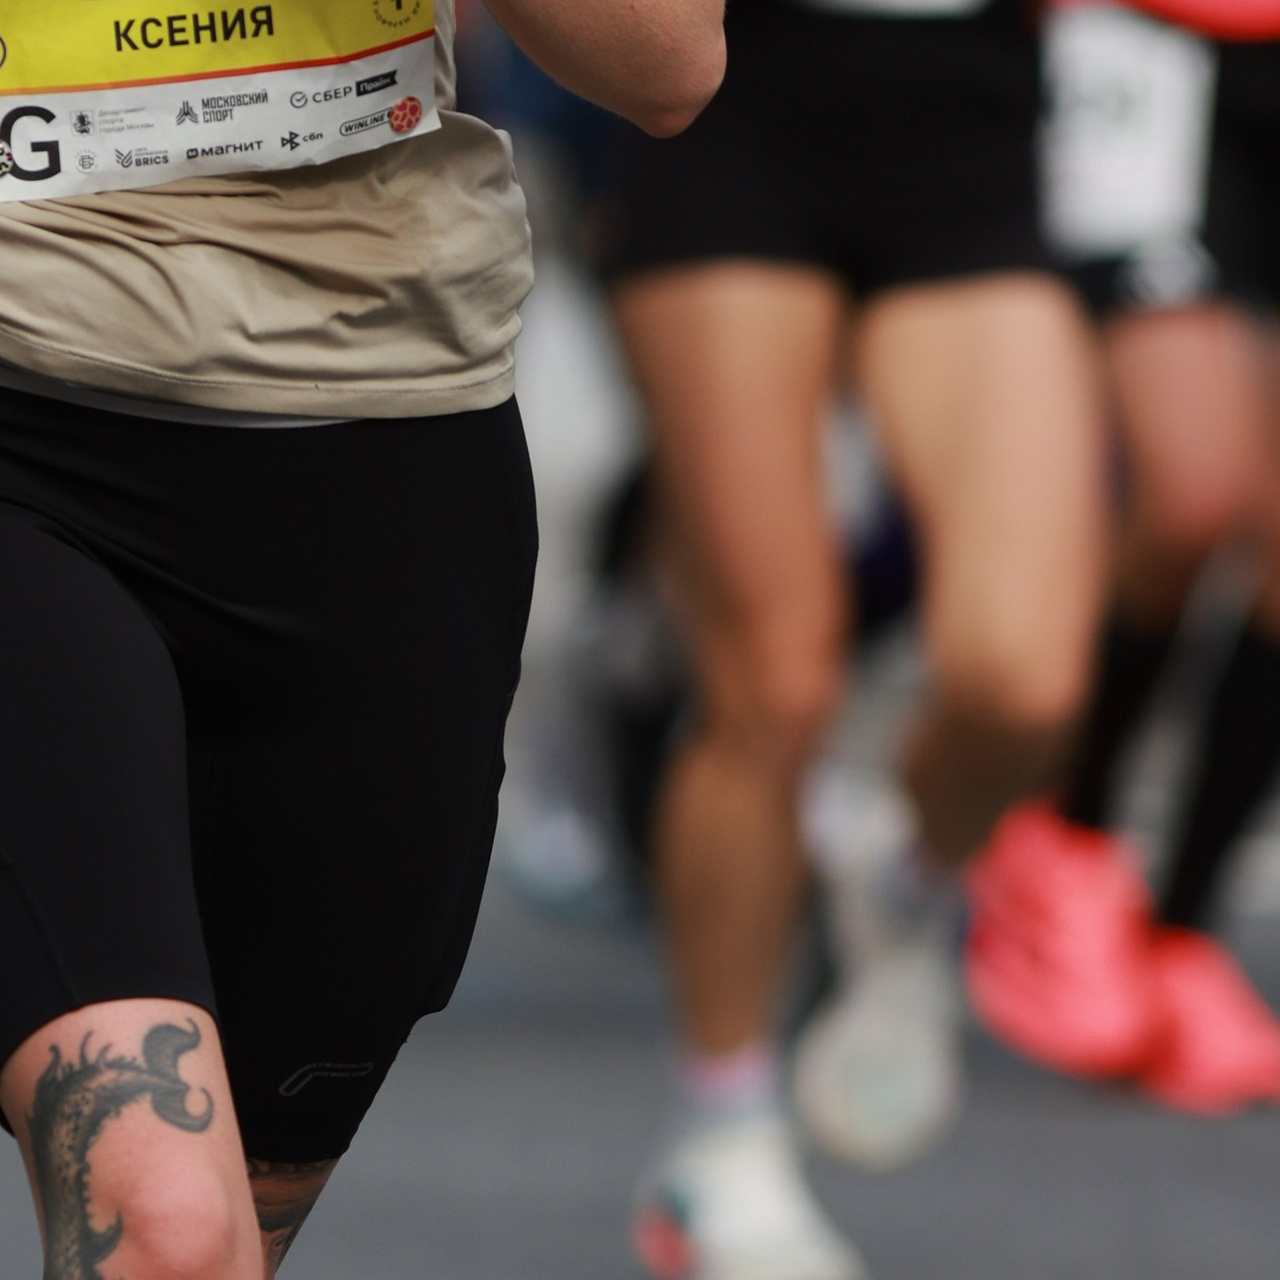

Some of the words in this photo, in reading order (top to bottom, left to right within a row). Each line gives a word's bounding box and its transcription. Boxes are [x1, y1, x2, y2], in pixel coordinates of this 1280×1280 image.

[113, 5, 274, 52] КСЕНИЯ
[201, 89, 268, 110] МОСКОВСКИЙ
[312, 87, 352, 104] СБЕР
[203, 107, 234, 123] СПОРТ
[344, 112, 386, 133] WINLINE
[0, 105, 61, 182] G
[135, 155, 169, 167] BRICS
